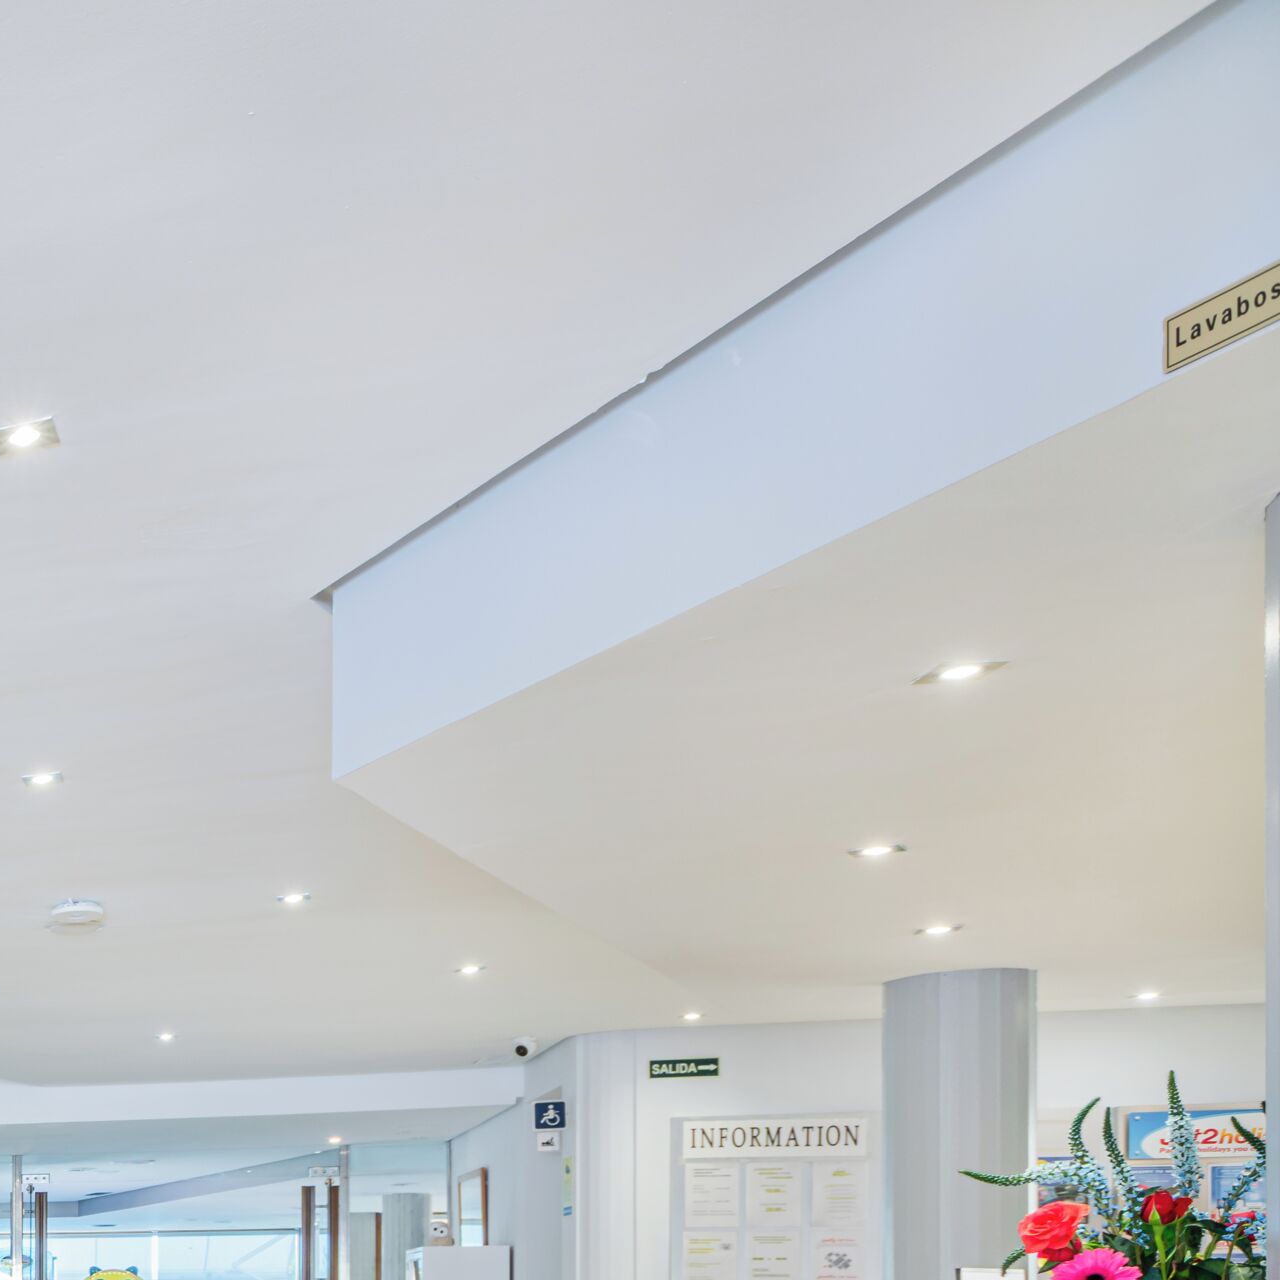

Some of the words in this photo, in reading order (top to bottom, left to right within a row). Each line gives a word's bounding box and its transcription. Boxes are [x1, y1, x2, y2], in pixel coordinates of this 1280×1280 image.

[1176, 282, 1280, 347] Lavabos
[651, 1062, 697, 1075] SALIDA
[690, 1124, 860, 1149] INFORMATION
